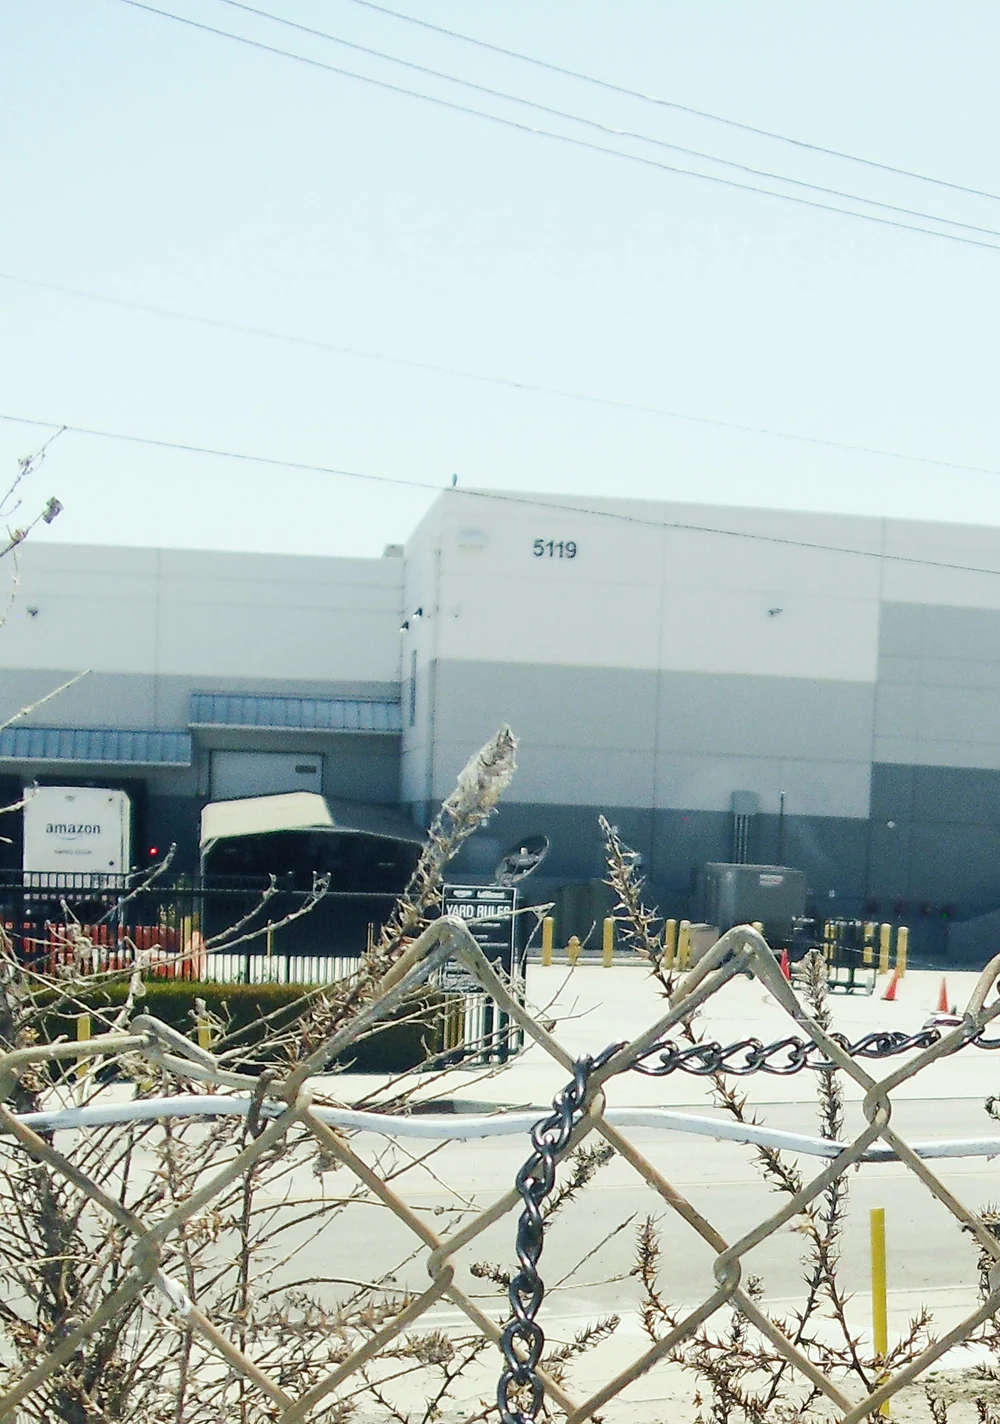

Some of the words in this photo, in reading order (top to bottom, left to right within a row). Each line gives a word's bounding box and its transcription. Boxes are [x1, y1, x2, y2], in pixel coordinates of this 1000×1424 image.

[533, 538, 577, 559] 5119
[45, 823, 101, 834] amazon
[446, 904, 475, 918] YARD
[477, 905, 511, 920] RULES
